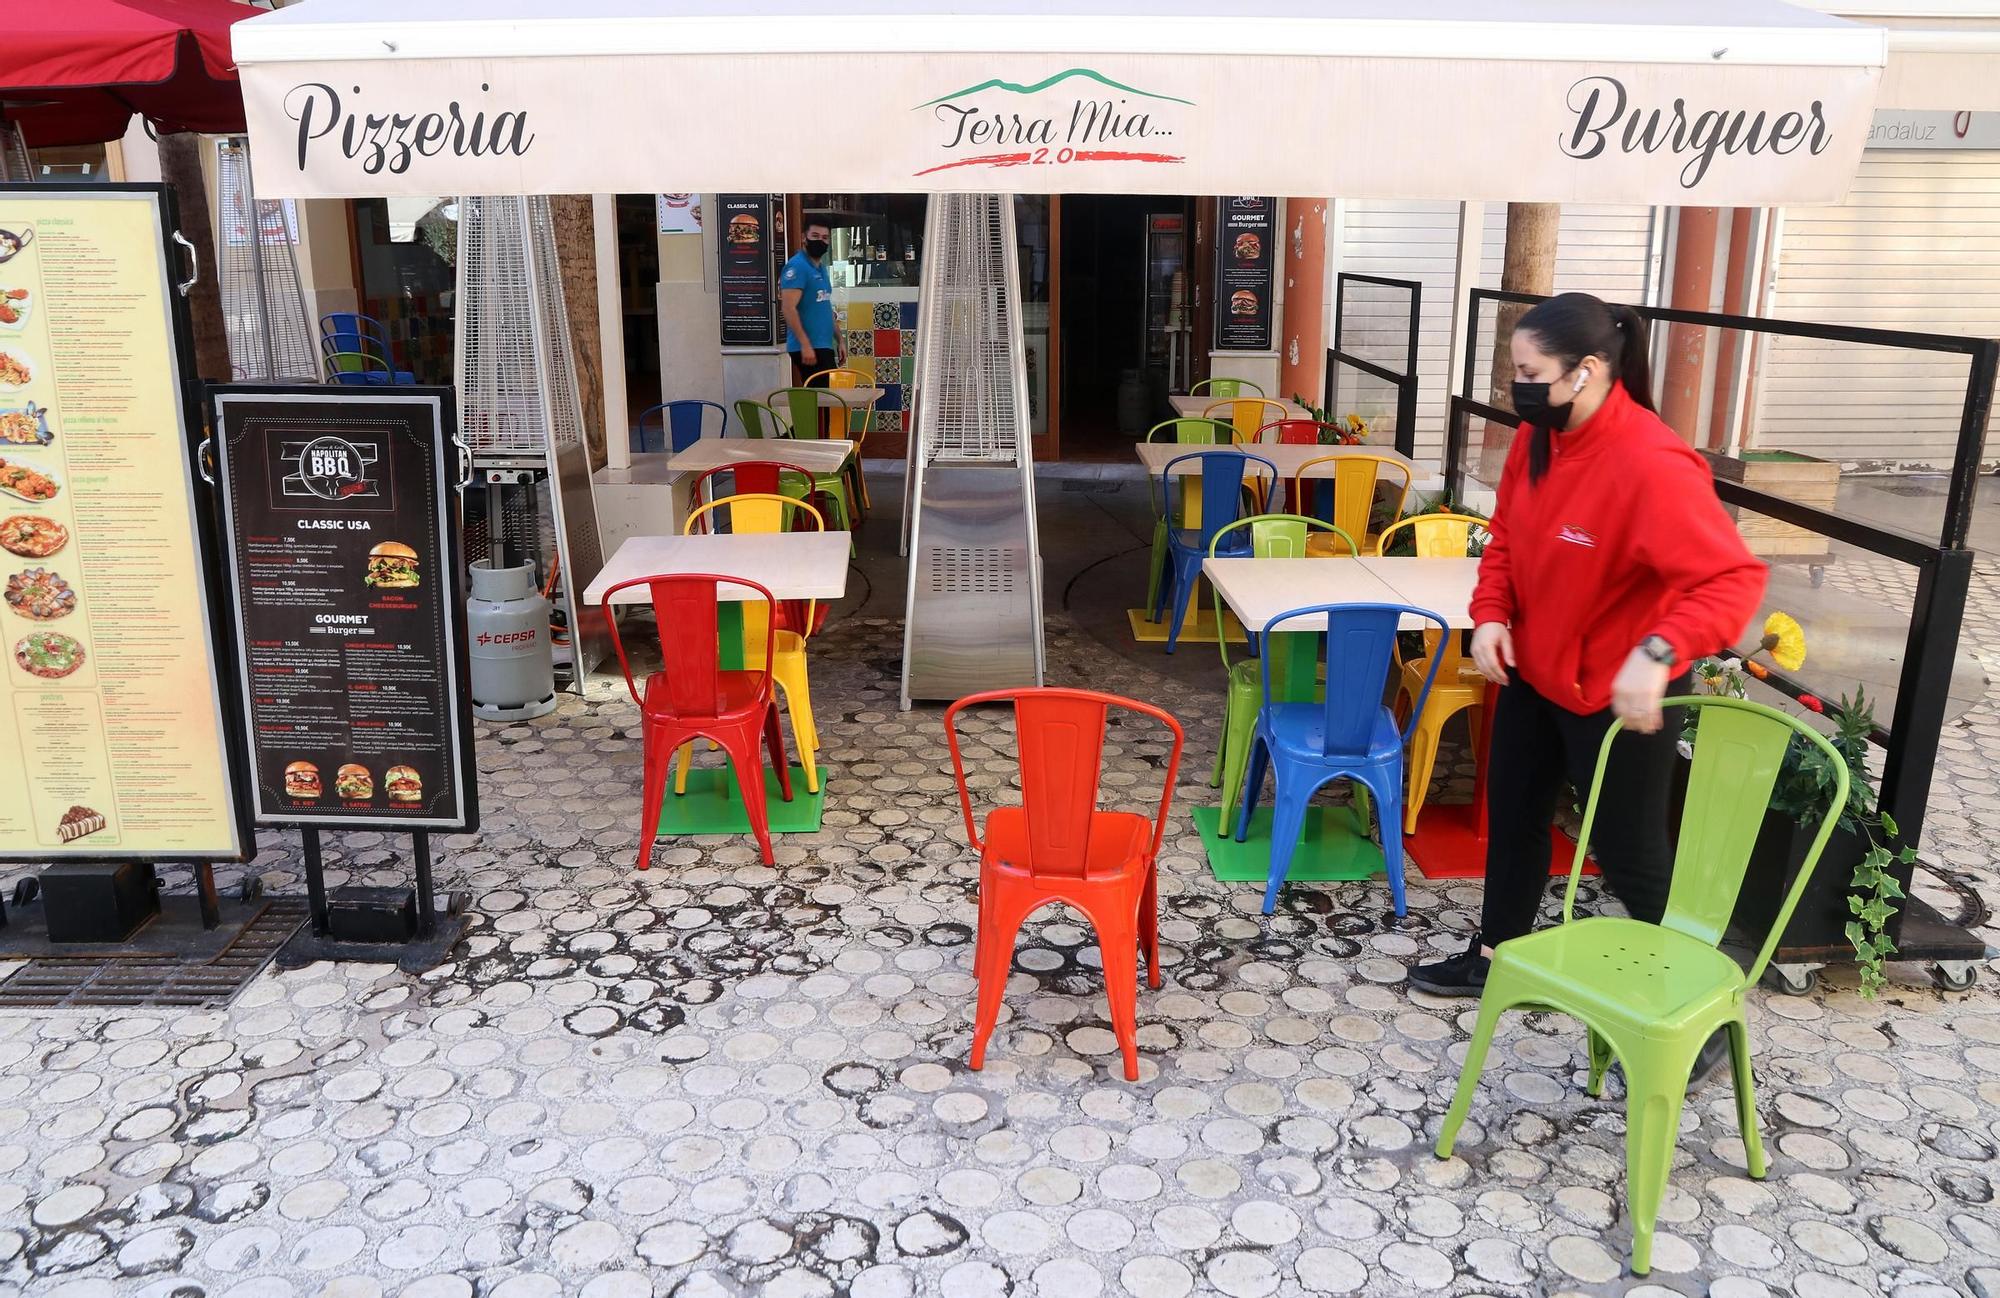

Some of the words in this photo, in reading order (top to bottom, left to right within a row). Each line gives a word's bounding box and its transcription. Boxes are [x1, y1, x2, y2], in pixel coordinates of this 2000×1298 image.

[283, 82, 535, 175] Pizzeria
[935, 103, 1057, 148] Terra
[1559, 76, 1832, 189] Burguer
[1031, 146, 1074, 165] 2.0
[311, 450, 348, 458] NAPOLITAN
[312, 457, 351, 477] BBQ
[297, 520, 345, 530] CLASSIC
[348, 520, 371, 531] USA
[316, 614, 368, 625] GOURMET
[327, 626, 358, 636] Burger
[494, 630, 536, 644] CEPSA
